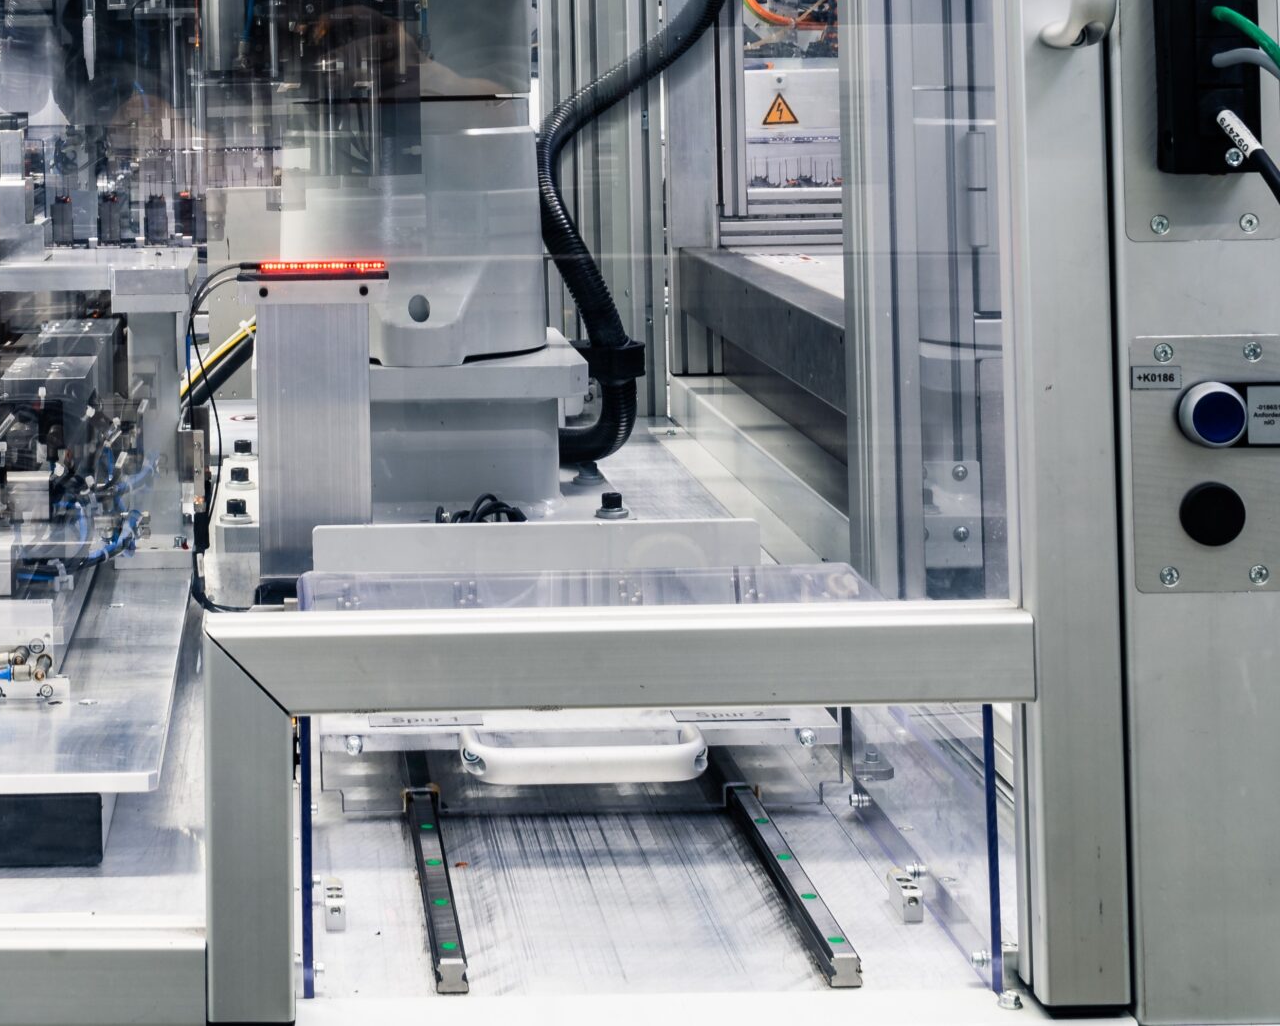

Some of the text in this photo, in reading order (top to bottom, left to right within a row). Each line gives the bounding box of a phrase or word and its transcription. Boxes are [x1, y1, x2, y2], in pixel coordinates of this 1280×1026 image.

[1219, 117, 1249, 153] 092479
[1136, 373, 1175, 383] +K0186
[695, 711, 745, 719] Spur
[391, 716, 441, 725] Spur
